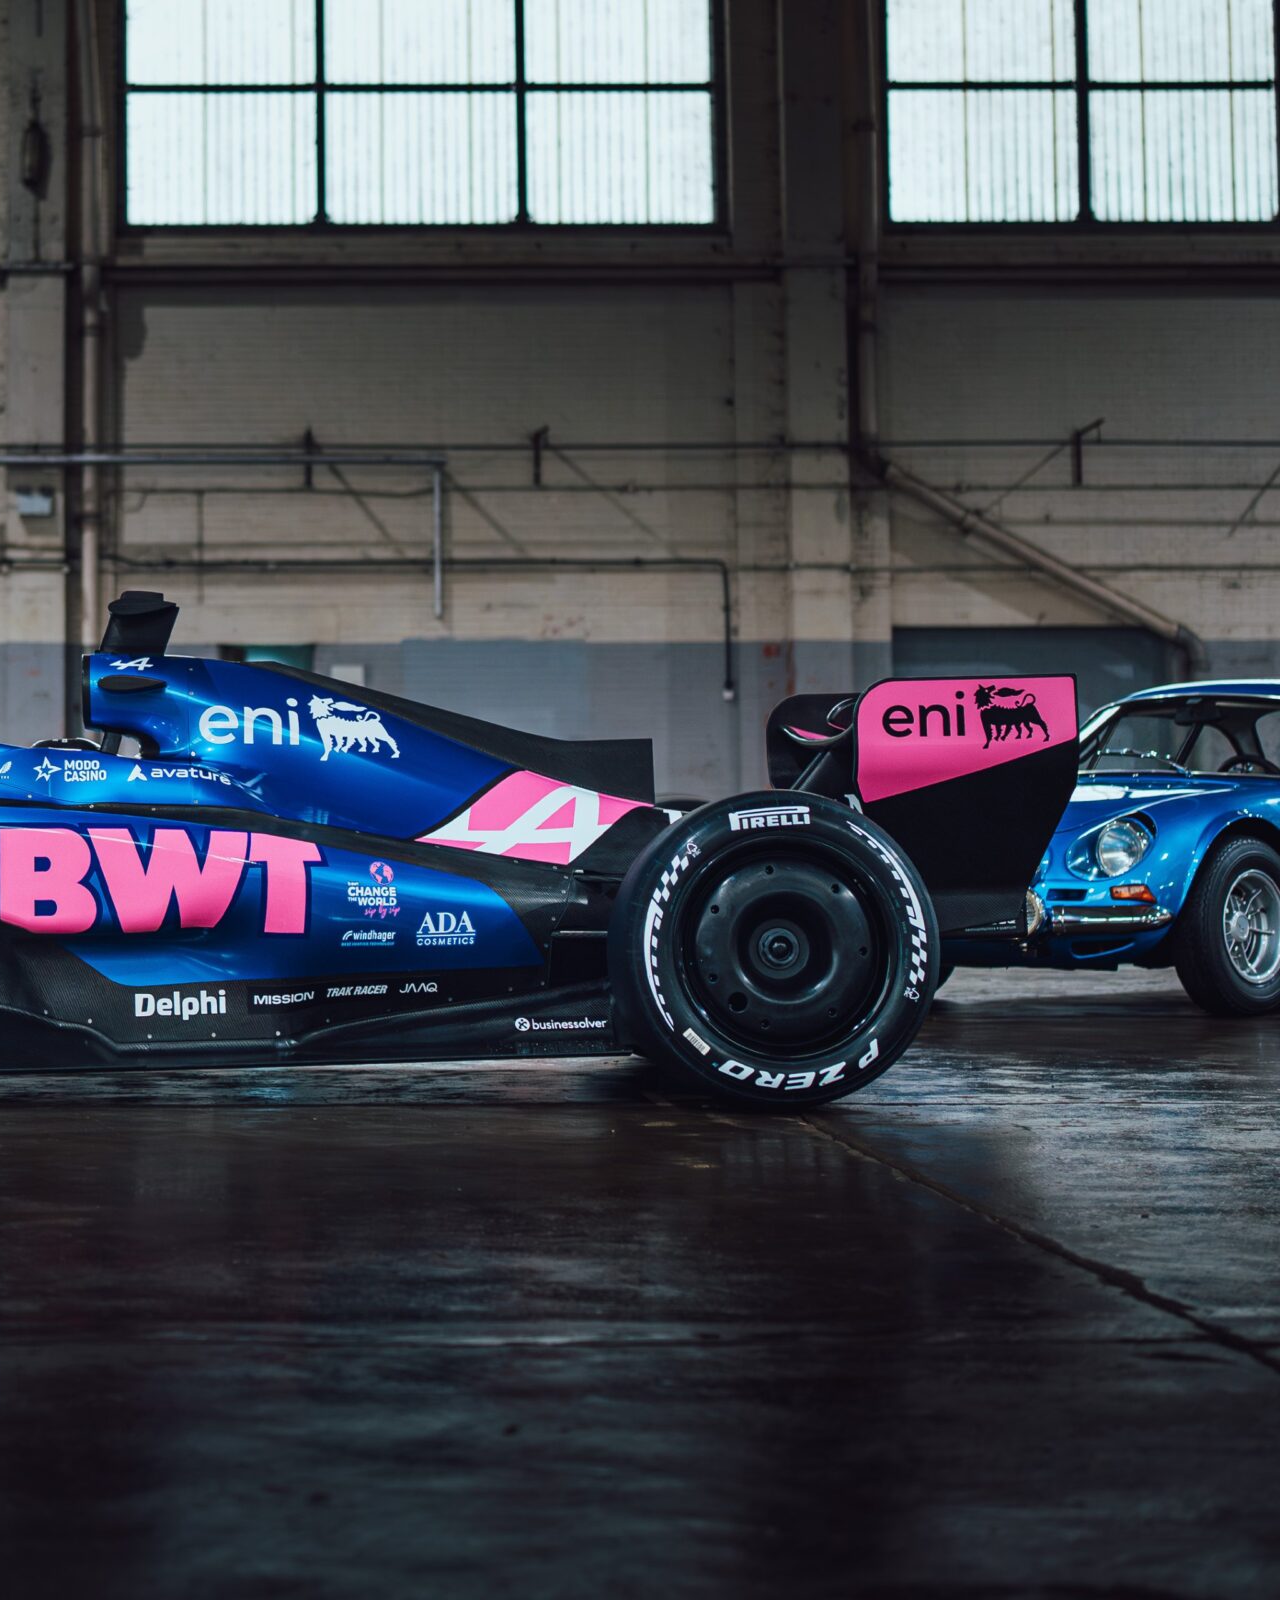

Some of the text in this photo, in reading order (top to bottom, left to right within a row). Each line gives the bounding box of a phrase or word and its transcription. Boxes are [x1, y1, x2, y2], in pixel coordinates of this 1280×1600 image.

[882, 690, 966, 738] eni
[198, 697, 300, 746] eni
[64, 759, 100, 770] MODO
[64, 769, 107, 782] CASINO
[150, 767, 232, 786] avature
[728, 805, 811, 831] PIRELLI
[0, 827, 322, 934] BWT
[347, 886, 397, 897] CHANGE
[358, 896, 397, 906] WORLD
[364, 906, 376, 918] sip
[388, 906, 400, 917] sip
[416, 910, 476, 934] ADA
[353, 929, 396, 942] windhager
[416, 937, 475, 946] COSMETICS
[253, 991, 315, 1005] MISSION
[326, 985, 388, 998] TRAK RACER
[134, 989, 227, 1020] Delphi
[531, 1017, 607, 1030] businessolver
[718, 1038, 879, 1090] P ZERO
